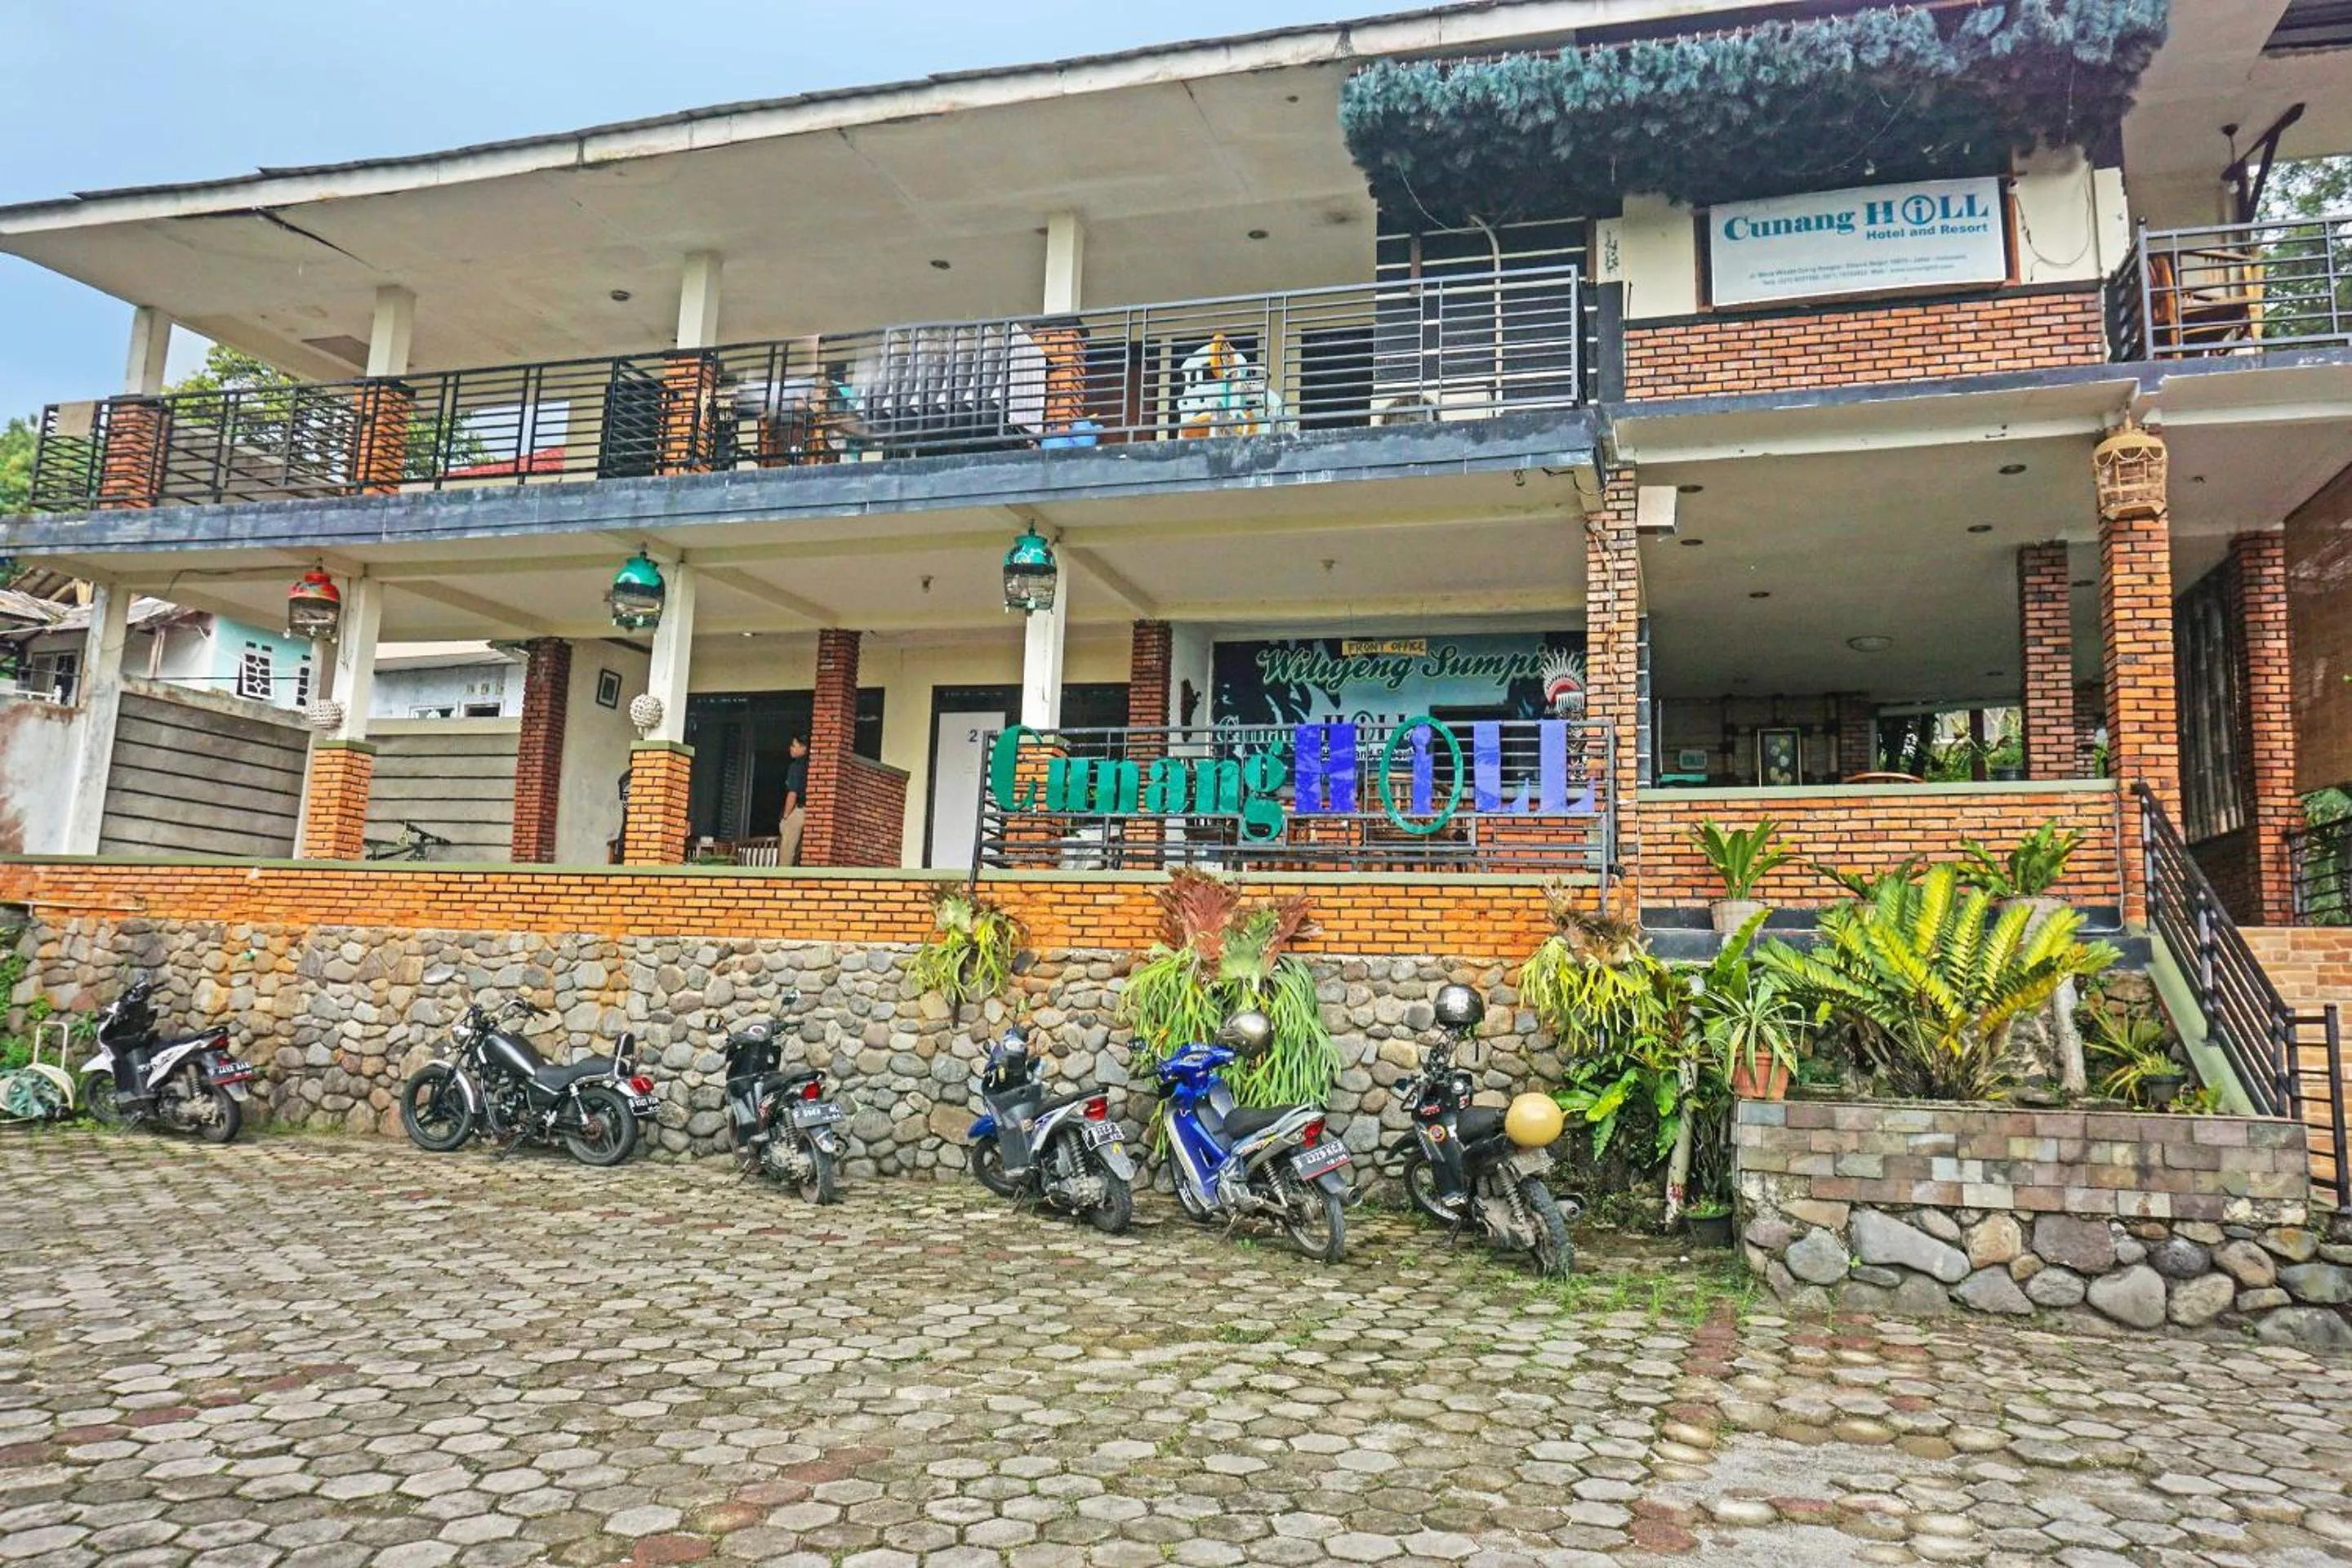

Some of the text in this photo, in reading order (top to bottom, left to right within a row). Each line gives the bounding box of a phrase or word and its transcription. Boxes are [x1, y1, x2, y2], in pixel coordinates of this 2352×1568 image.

[1724, 211, 1855, 241] Cunang
[1866, 222, 1989, 240] Hotel and Resort
[1348, 639, 1425, 653] FRONT OFFICE
[1421, 643, 1586, 686] Sumpi
[968, 728, 978, 742] 2
[991, 724, 1287, 843] Cunang
